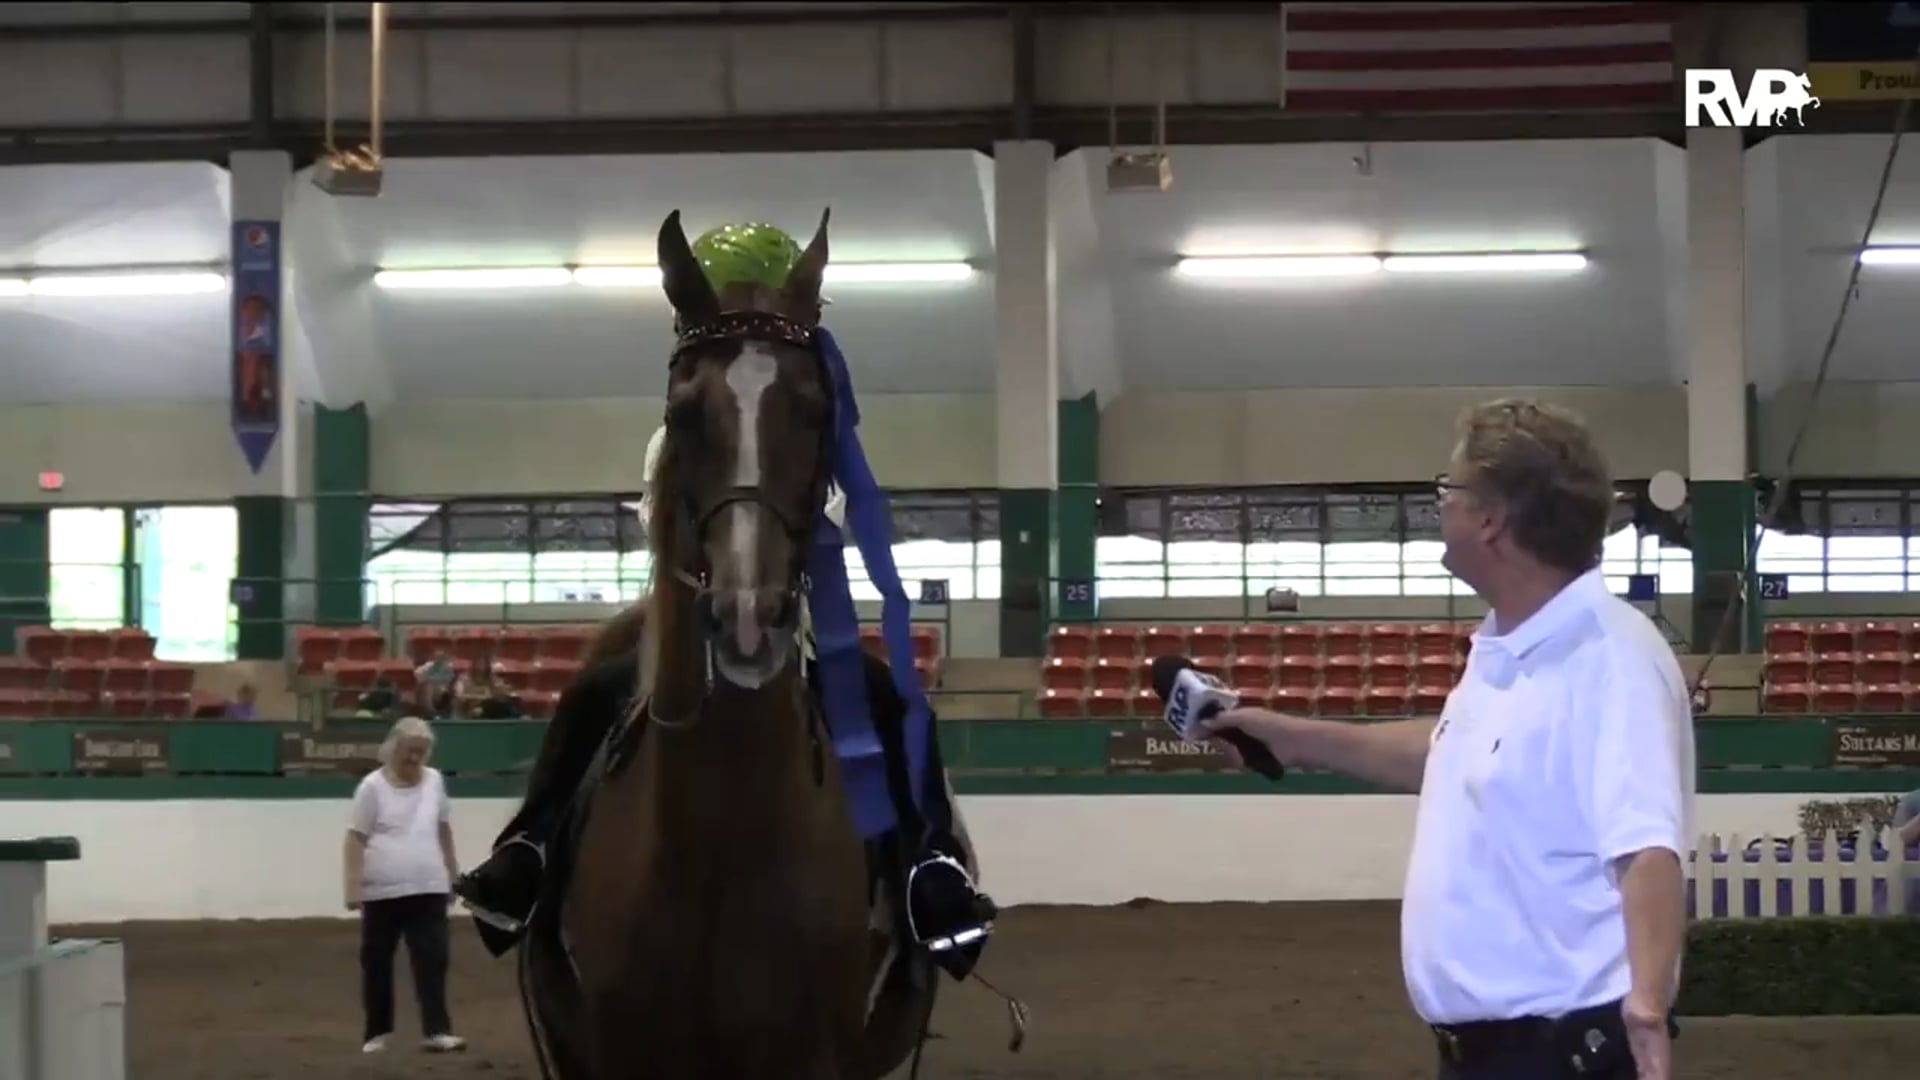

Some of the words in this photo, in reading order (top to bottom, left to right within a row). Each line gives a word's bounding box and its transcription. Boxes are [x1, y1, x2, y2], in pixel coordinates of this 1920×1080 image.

[1859, 69, 1920, 90] Prou
[923, 584, 943, 602] 23
[1066, 584, 1089, 602] 25
[1763, 580, 1785, 598] 27
[1904, 733, 1920, 752] M
